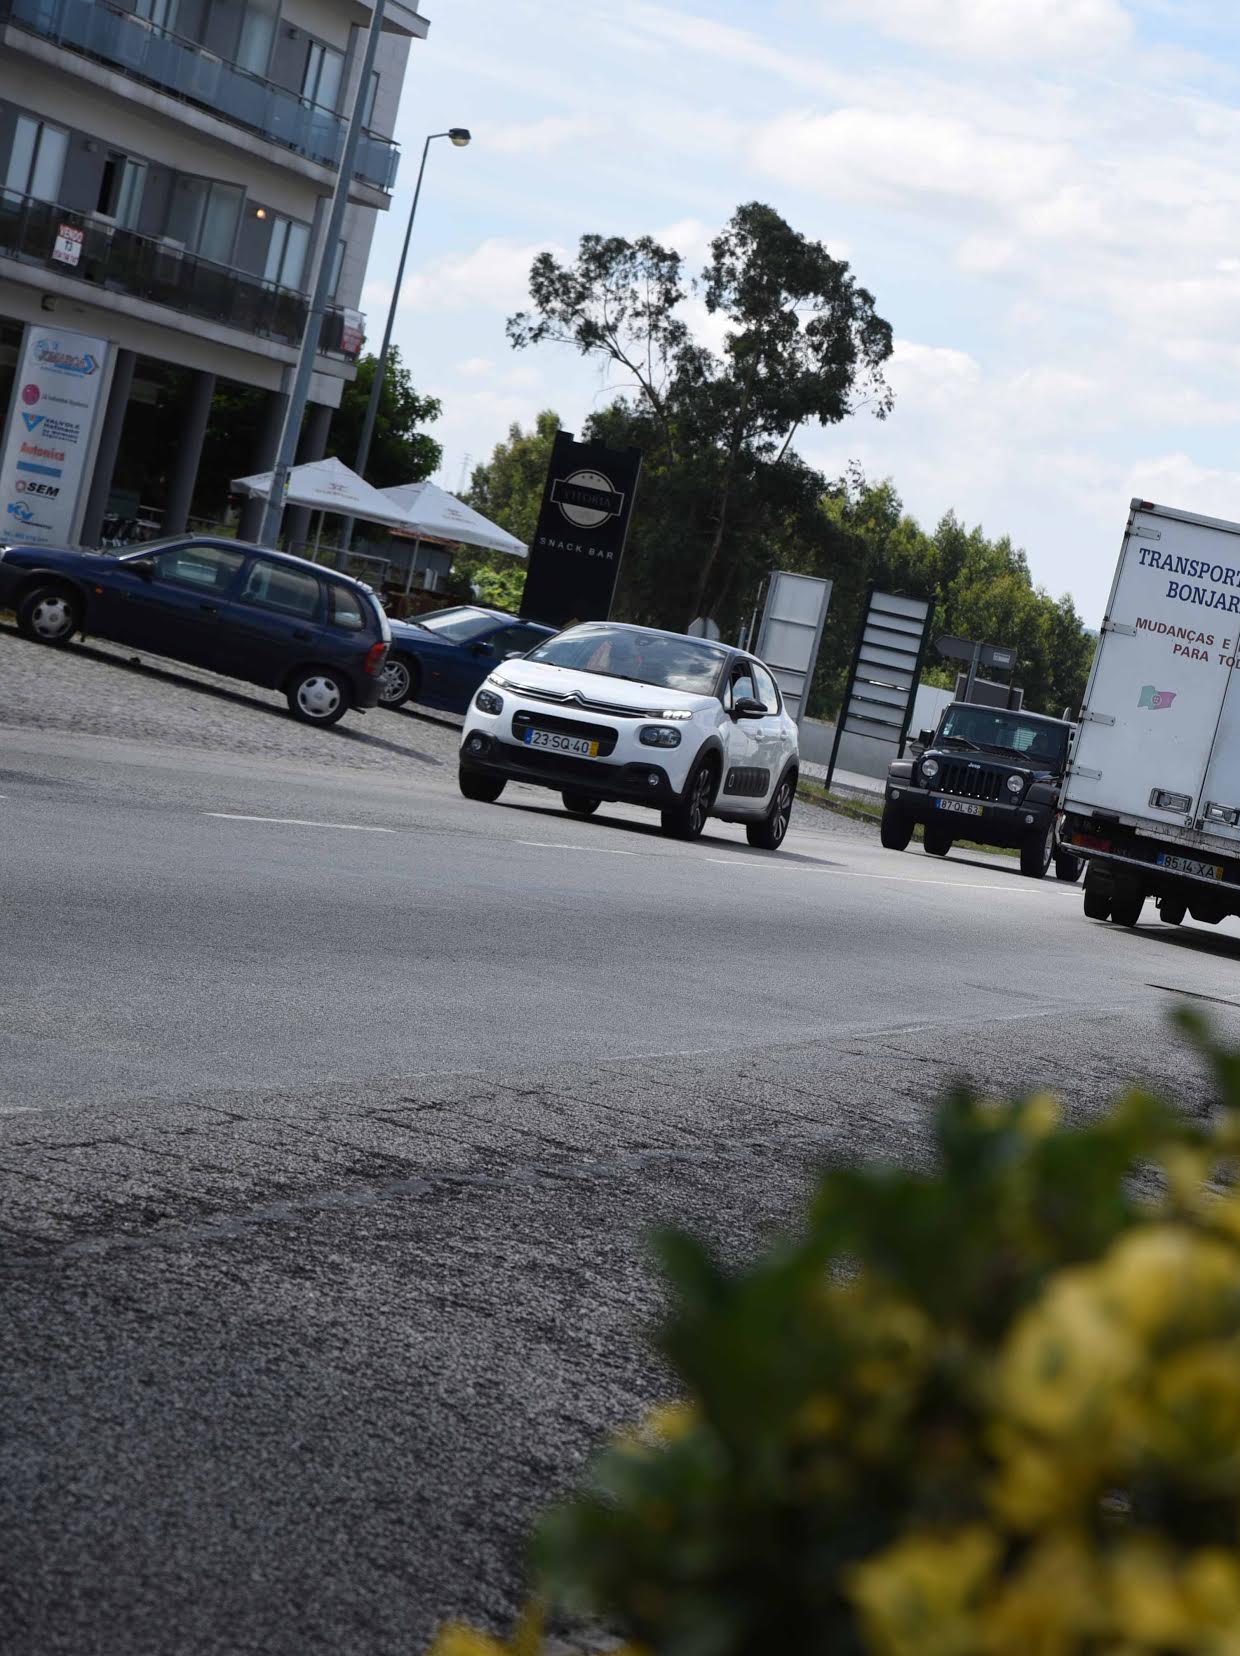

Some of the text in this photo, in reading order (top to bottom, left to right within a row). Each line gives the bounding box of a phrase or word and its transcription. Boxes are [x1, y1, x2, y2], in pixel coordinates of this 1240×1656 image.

[20, 442, 64, 461] Autonics
[27, 482, 60, 497] SEM
[539, 537, 582, 552] SNACK
[588, 547, 614, 560] BAR
[1135, 617, 1215, 645] MUDANÇAS
[1222, 638, 1231, 650] E
[1173, 644, 1209, 662] PARA
